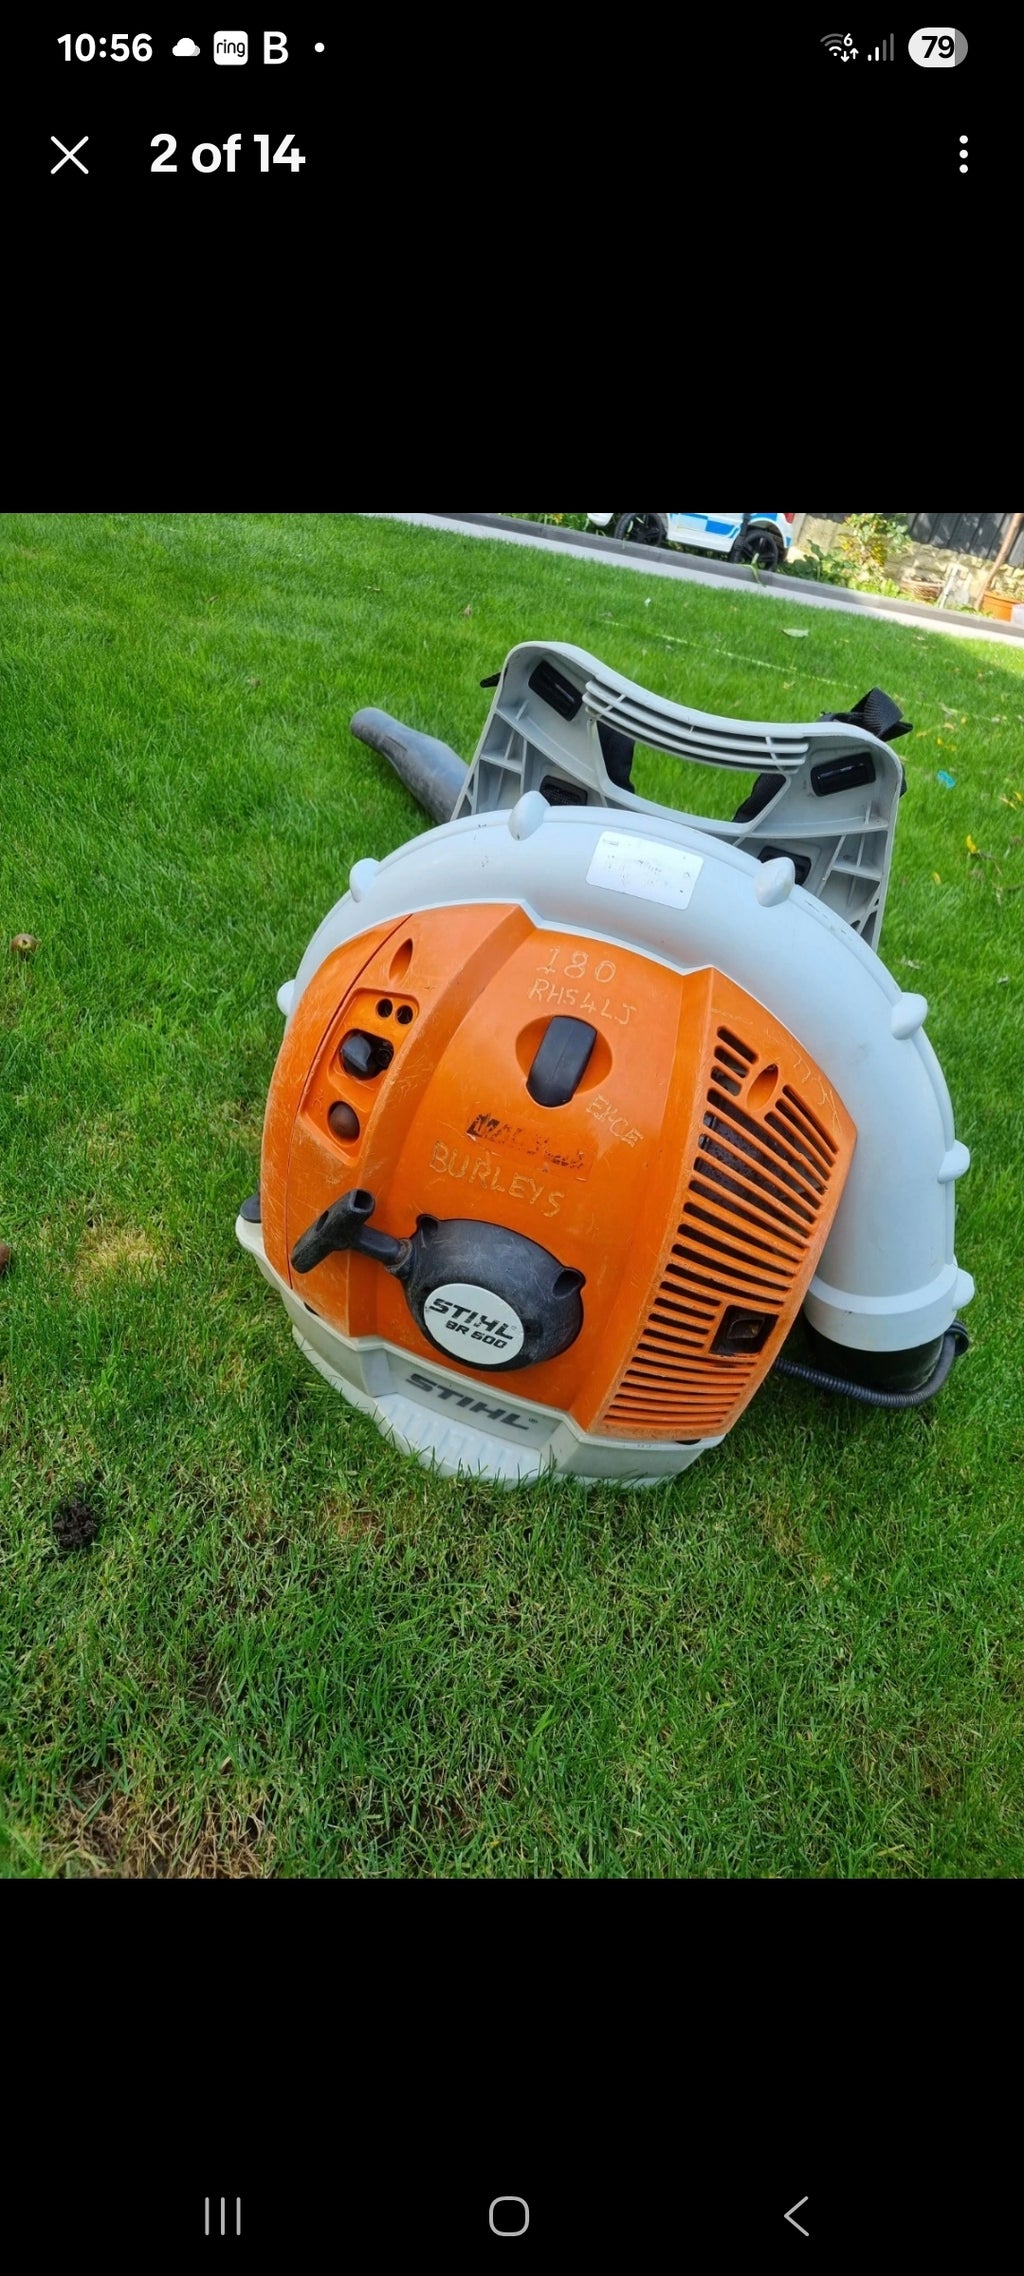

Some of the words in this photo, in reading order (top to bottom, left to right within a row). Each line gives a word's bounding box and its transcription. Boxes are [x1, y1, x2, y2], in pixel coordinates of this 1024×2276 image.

[536, 946, 617, 983] 180
[429, 1140, 565, 1217] BURLEYS
[429, 1298, 514, 1340] STIHL
[445, 1320, 470, 1335] BR
[406, 1373, 530, 1431] STIHL
